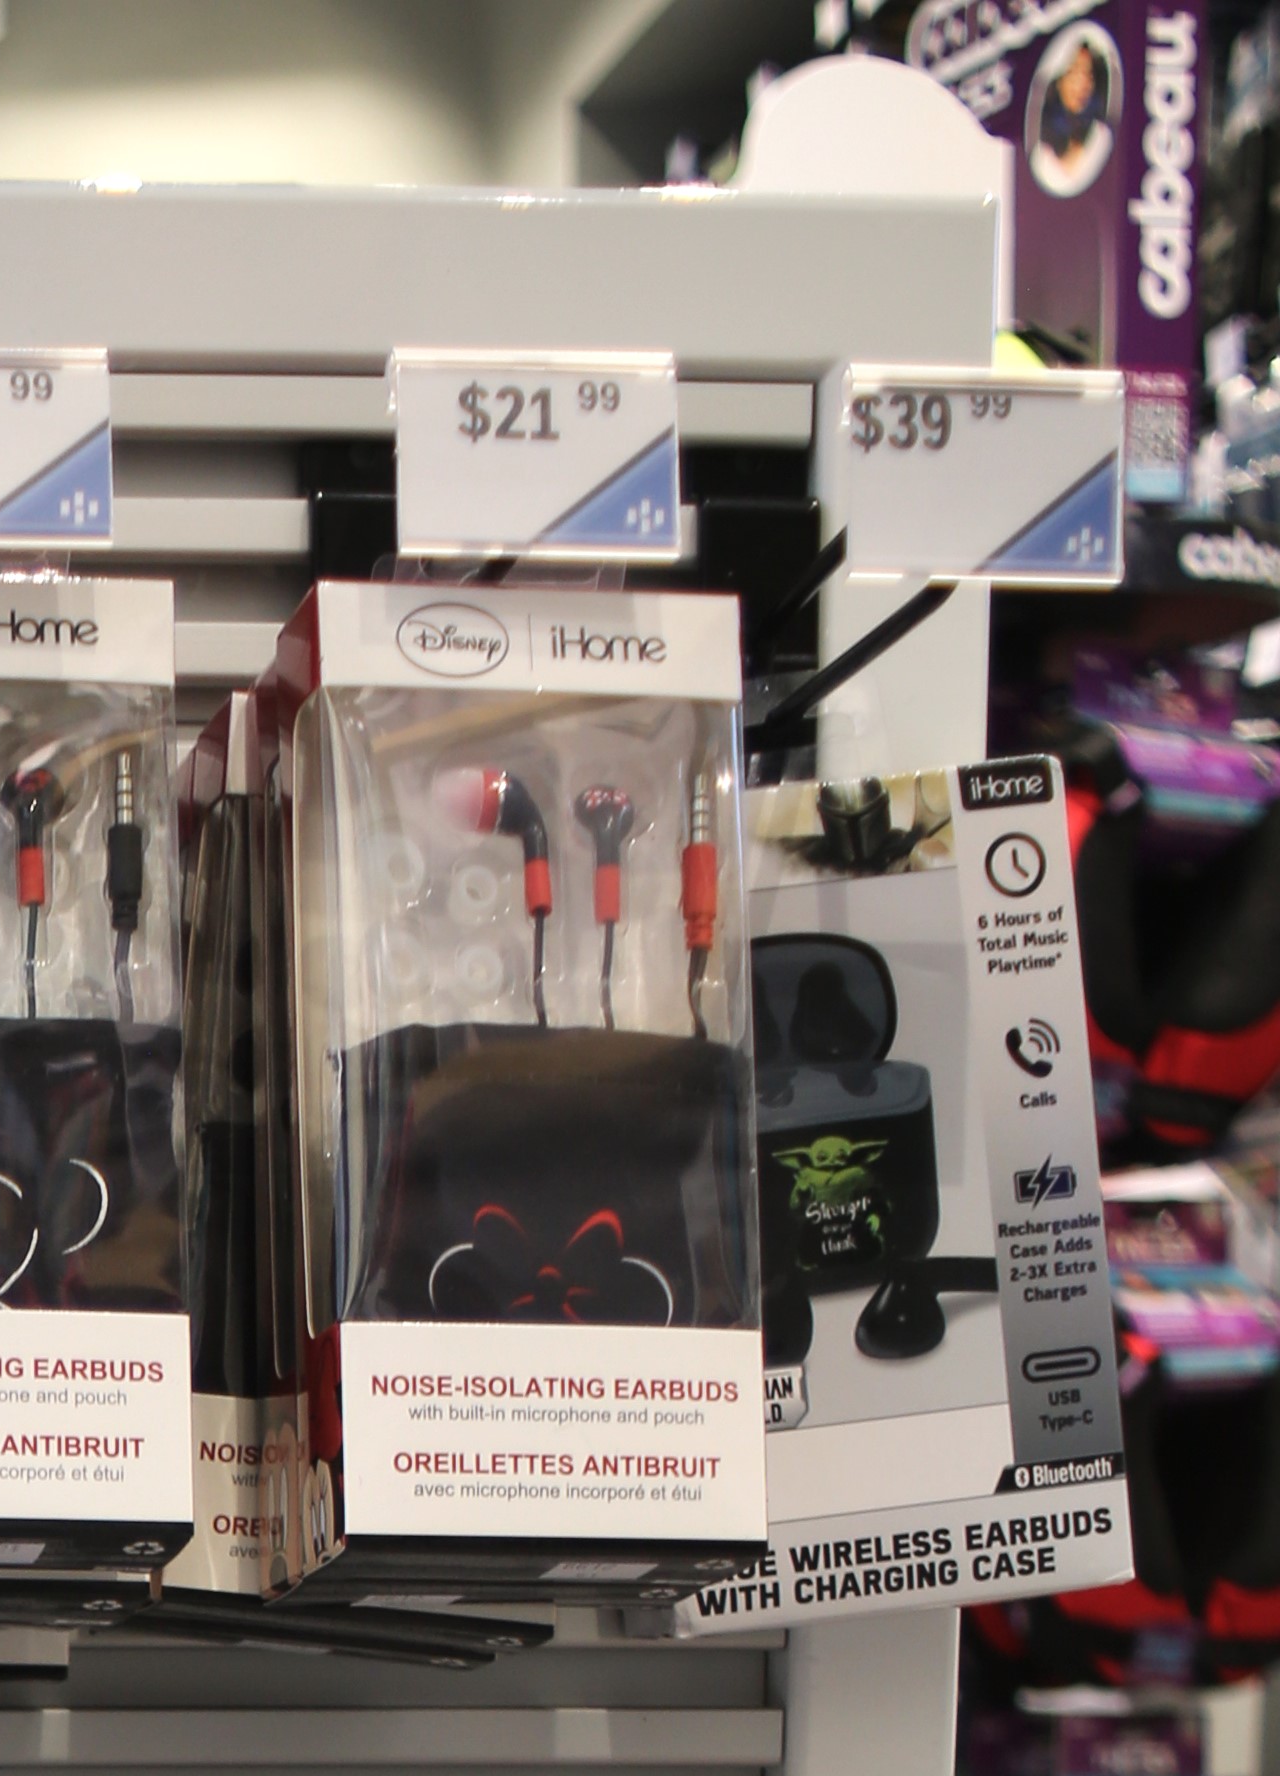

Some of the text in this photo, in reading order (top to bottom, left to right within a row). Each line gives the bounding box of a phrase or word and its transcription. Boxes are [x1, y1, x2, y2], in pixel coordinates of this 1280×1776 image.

[9, 371, 54, 401] 99
[458, 381, 621, 442] $21 99
[851, 393, 1012, 453] $39 99
[407, 619, 667, 663] Disney iHome
[969, 774, 1044, 800] iHome
[978, 906, 1064, 929] 6 Hours of
[978, 930, 1068, 952] Total Music
[1020, 1093, 1057, 1108] Calls
[999, 1214, 1100, 1238] Rechargeable
[1010, 1239, 1092, 1259] Case Adds
[1010, 1261, 1096, 1282] 2-3X Extra
[1024, 1283, 1087, 1302] Charges
[33, 1358, 164, 1382] EARBUDS
[371, 1375, 738, 1402] NOISE-ISOLATING EARBUDS
[1048, 1389, 1080, 1405] USB
[1039, 1410, 1093, 1432] Type-C
[1, 1435, 145, 1458] ANTIBRUIT
[393, 1452, 721, 1478] OREILLETTES ANTIBRUIT
[1032, 1457, 1113, 1487] Bluetooth
[790, 1507, 1112, 1573] WIRELESS EARBUDS
[696, 1547, 1056, 1617] WITH CHARGING CASE
